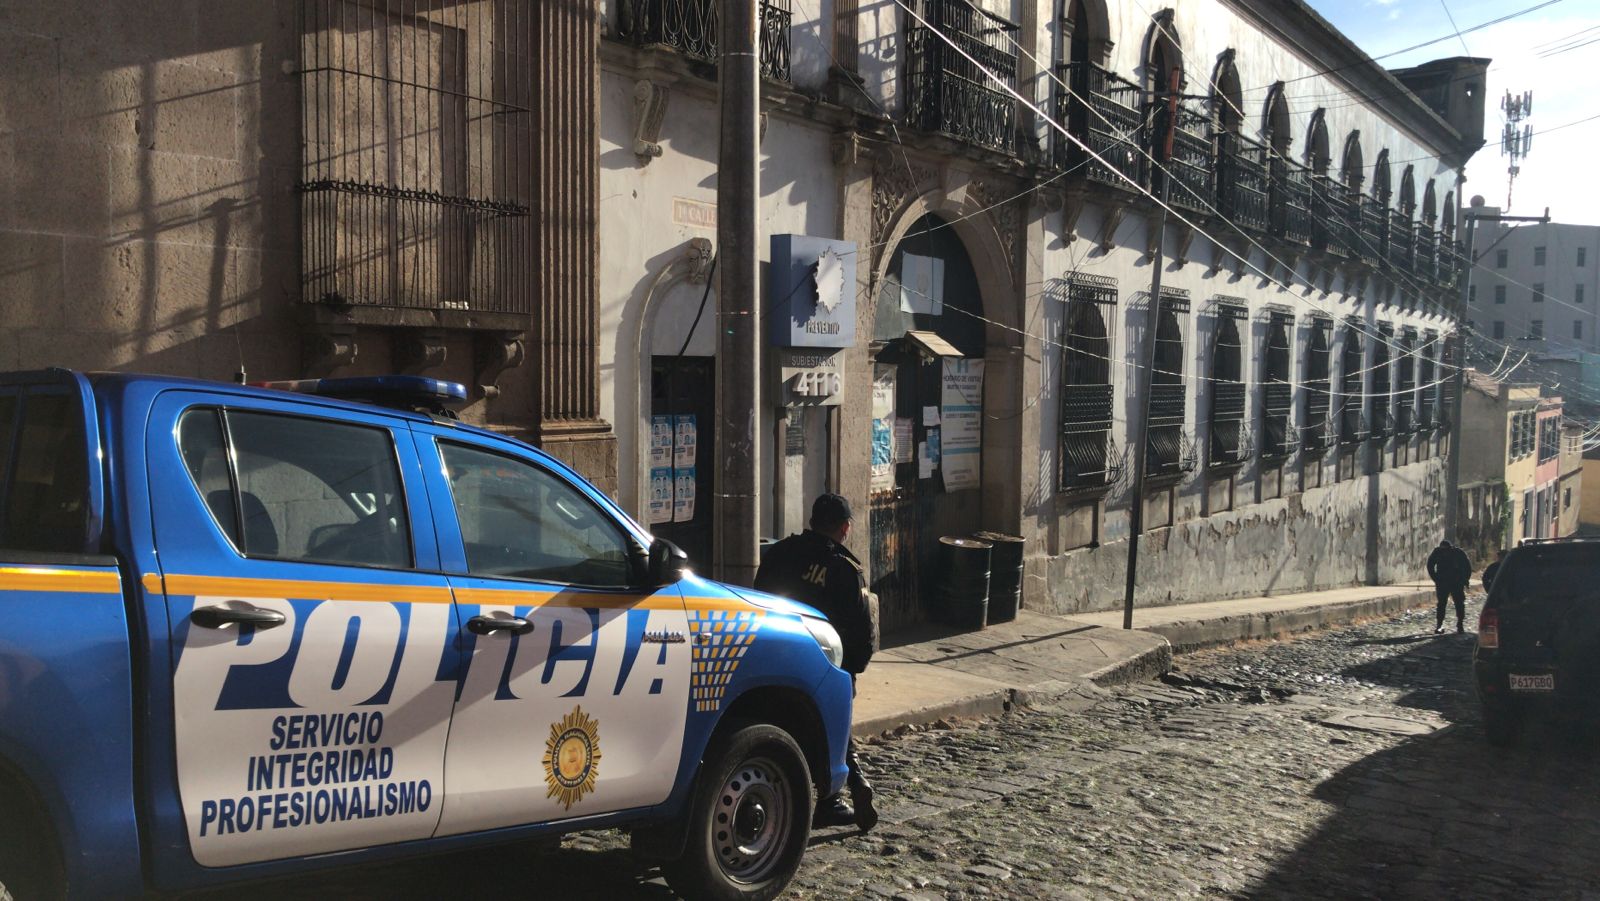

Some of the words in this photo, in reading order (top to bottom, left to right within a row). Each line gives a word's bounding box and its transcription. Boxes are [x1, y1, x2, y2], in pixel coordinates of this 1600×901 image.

[806, 320, 840, 335] PREVENTIVO
[792, 372, 841, 396] 4116
[178, 596, 690, 711] POLICIA
[270, 711, 383, 750] SERVICIO
[247, 747, 393, 791] INTEGRIDAD
[200, 779, 431, 836] PROFESIONALISMO
